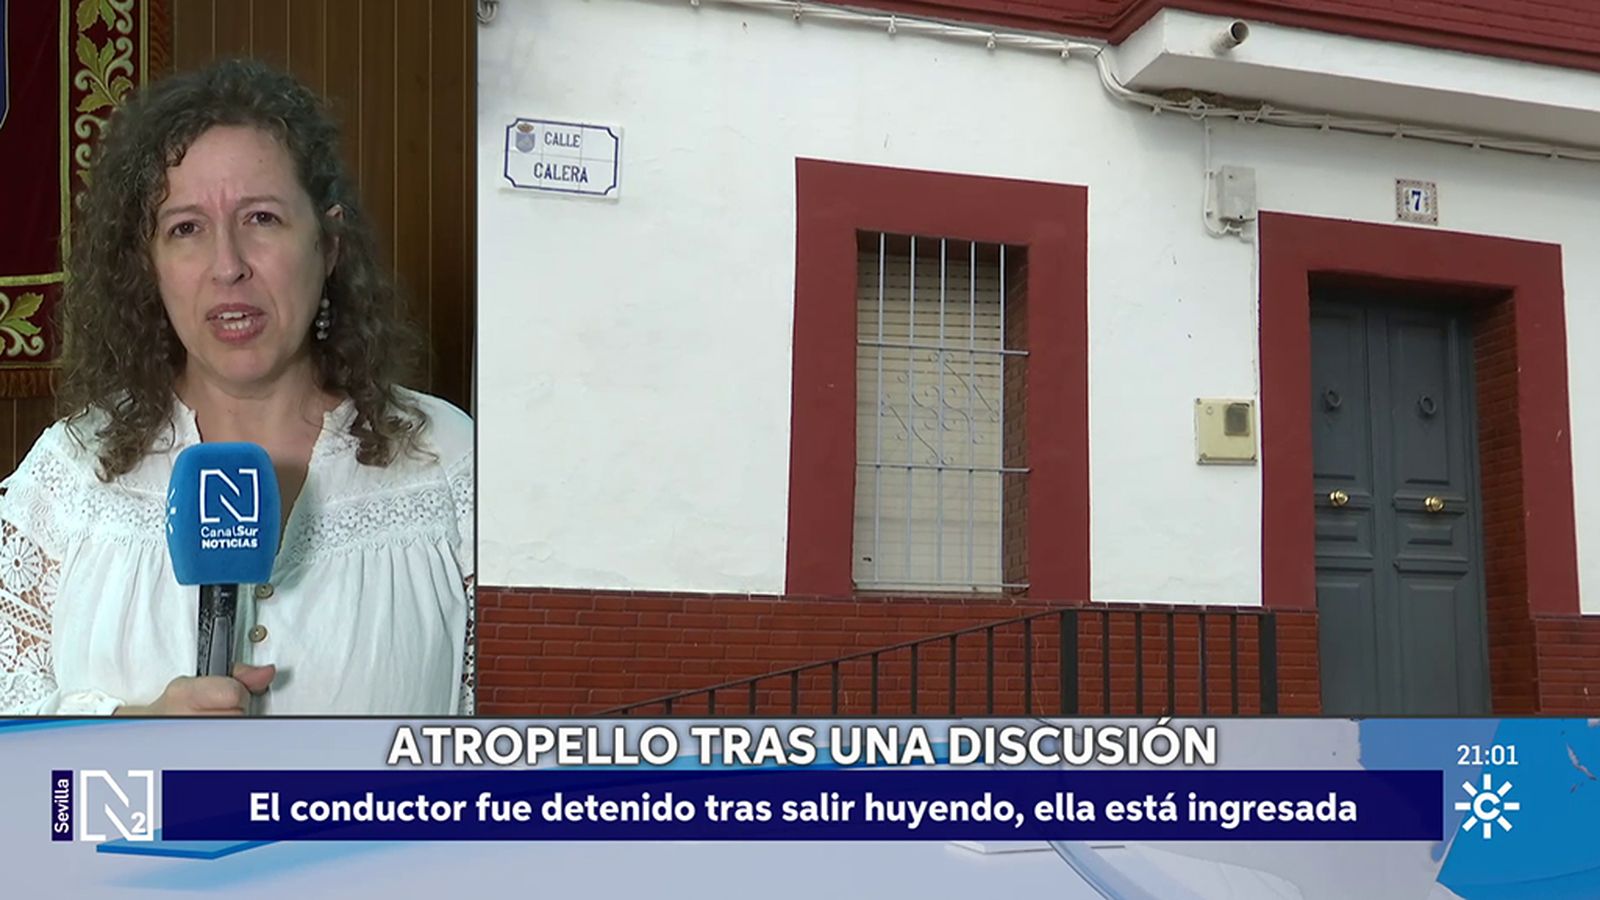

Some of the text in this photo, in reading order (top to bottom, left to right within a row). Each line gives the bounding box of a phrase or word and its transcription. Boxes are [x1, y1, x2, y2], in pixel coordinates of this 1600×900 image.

[544, 131, 581, 148] CALLE
[533, 162, 588, 183] CALERA
[1411, 190, 1421, 211] 7
[201, 538, 258, 549] NOTICIAS
